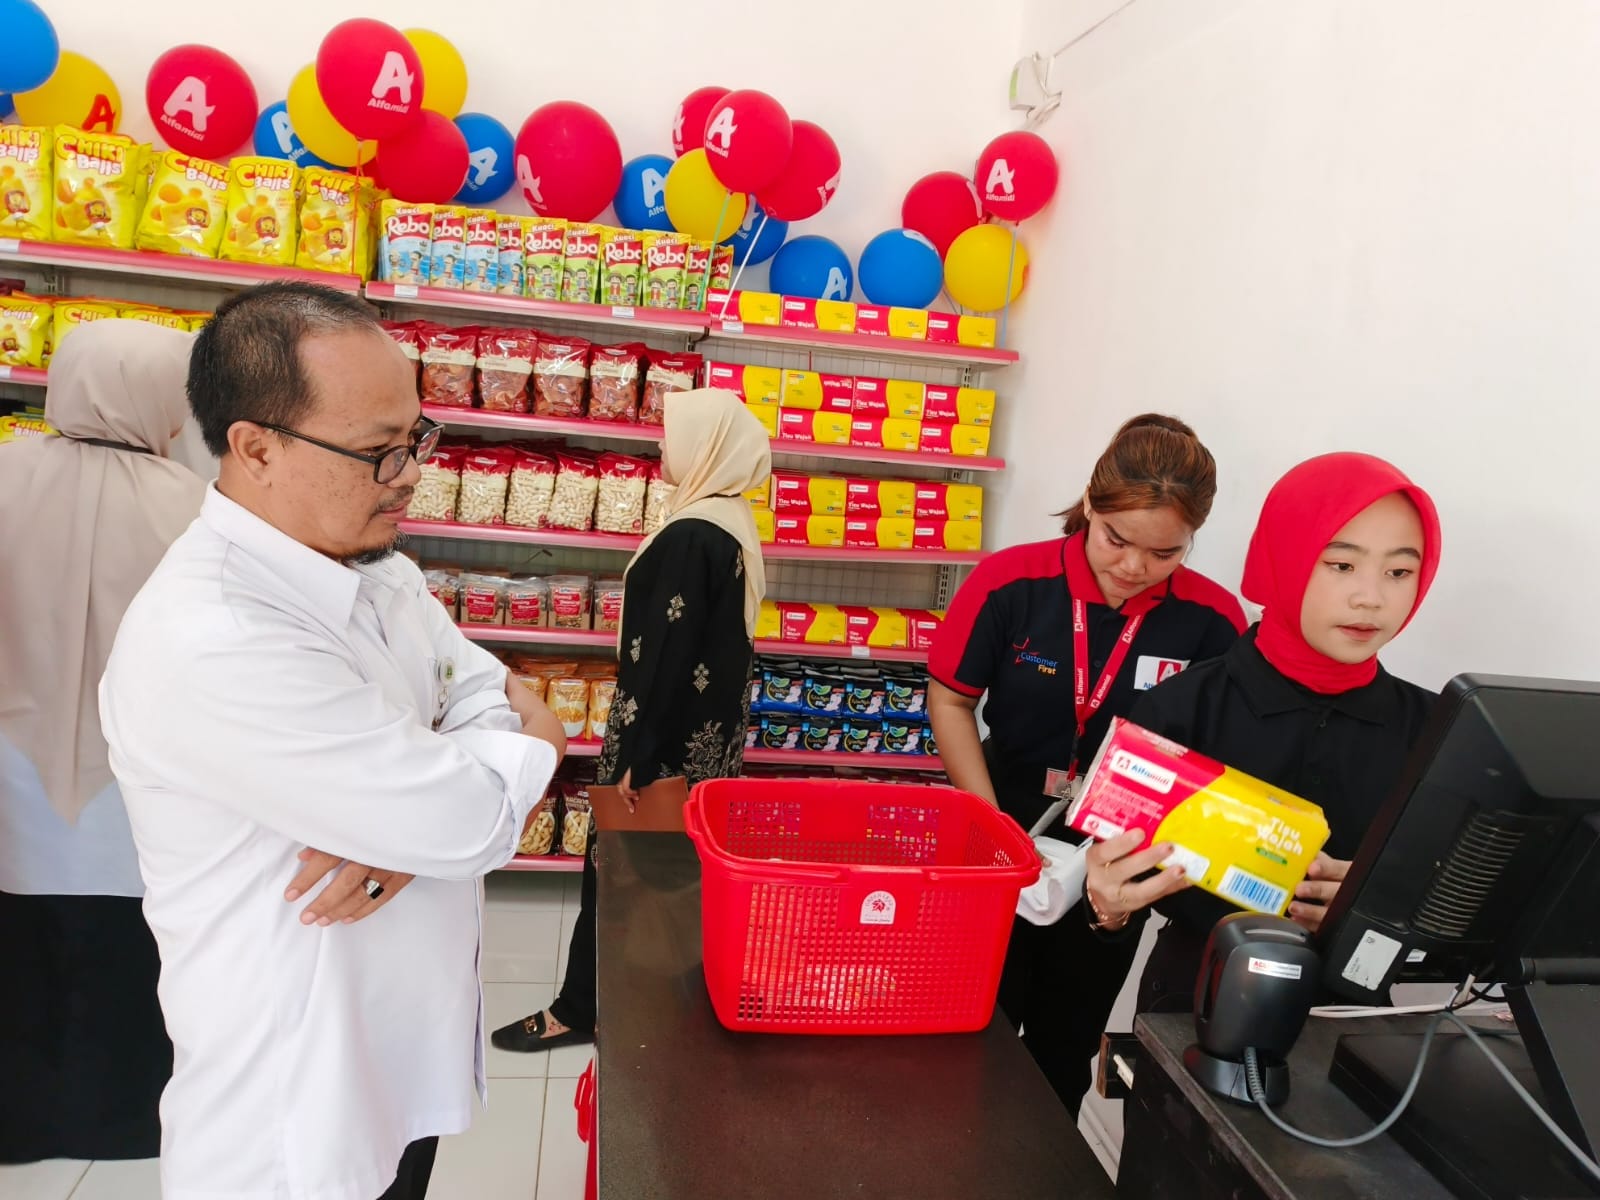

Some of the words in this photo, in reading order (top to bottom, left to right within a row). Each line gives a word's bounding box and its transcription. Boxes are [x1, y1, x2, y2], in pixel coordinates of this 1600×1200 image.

[76, 153, 122, 176] Balls
[235, 164, 295, 188] CHIKI
[186, 167, 228, 192] Balls
[386, 212, 430, 237] Rebo
[433, 216, 464, 239] ebo
[467, 220, 496, 243] ebo
[525, 230, 562, 252] Rebo
[566, 236, 598, 257] ebo
[648, 245, 686, 267] Rebo
[1020, 651, 1059, 668] Customer
[1038, 664, 1057, 675] First
[1271, 816, 1301, 841] Tisu
